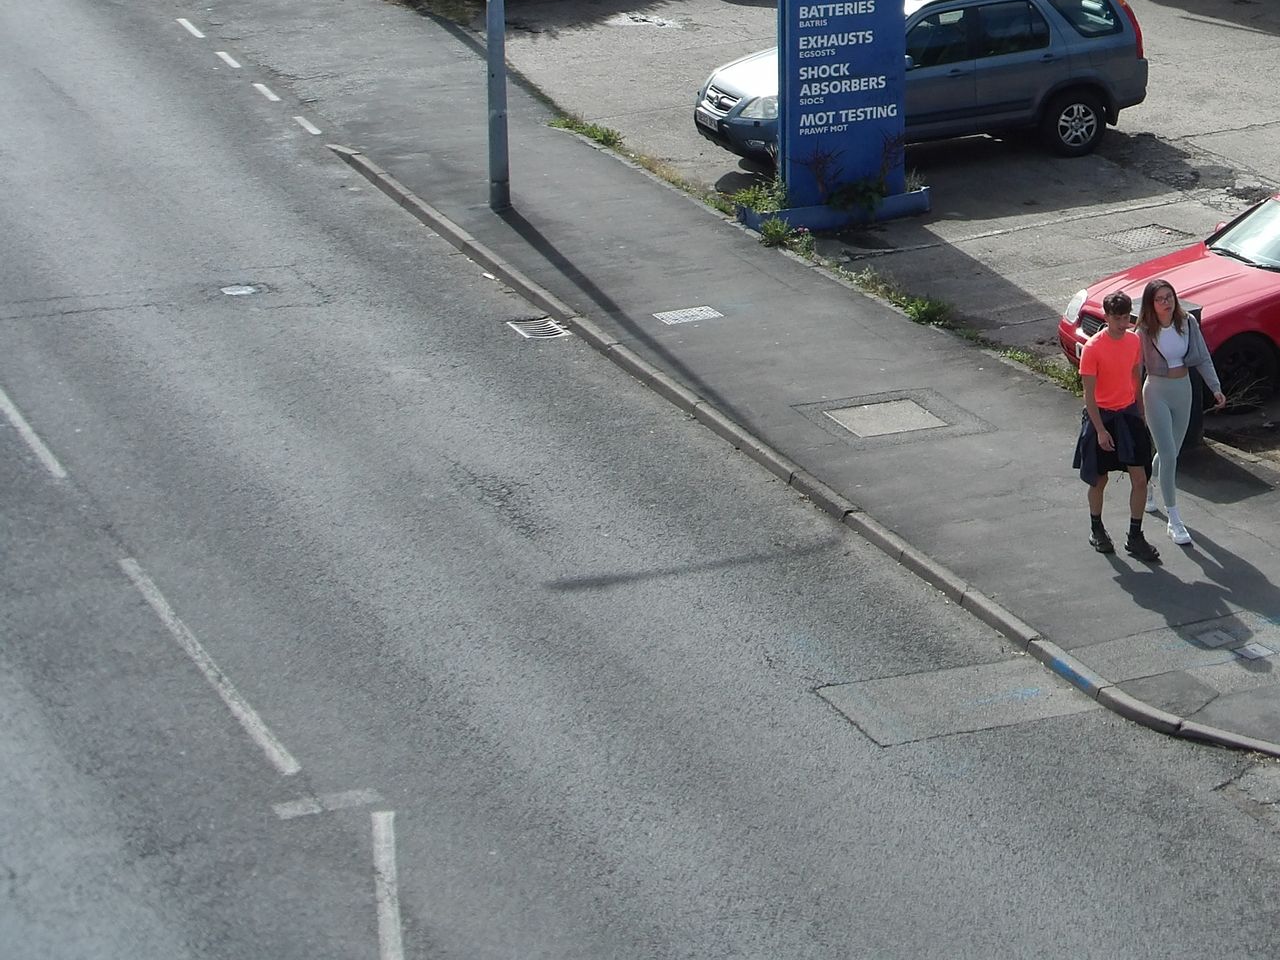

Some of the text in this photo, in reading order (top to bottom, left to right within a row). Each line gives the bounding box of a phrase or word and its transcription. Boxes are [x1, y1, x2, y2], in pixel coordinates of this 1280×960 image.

[800, 0, 875, 19] BATTERIES
[799, 19, 828, 28] BATRIS
[800, 31, 873, 49] EXHAUSTS
[800, 49, 836, 58] EGSOSTS
[800, 63, 850, 80] SHOCK
[800, 76, 886, 97] ABSORBERS
[800, 97, 824, 105] SIOCS
[800, 104, 897, 127] MOT TESTING
[800, 124, 848, 135] PRAWF MOT
